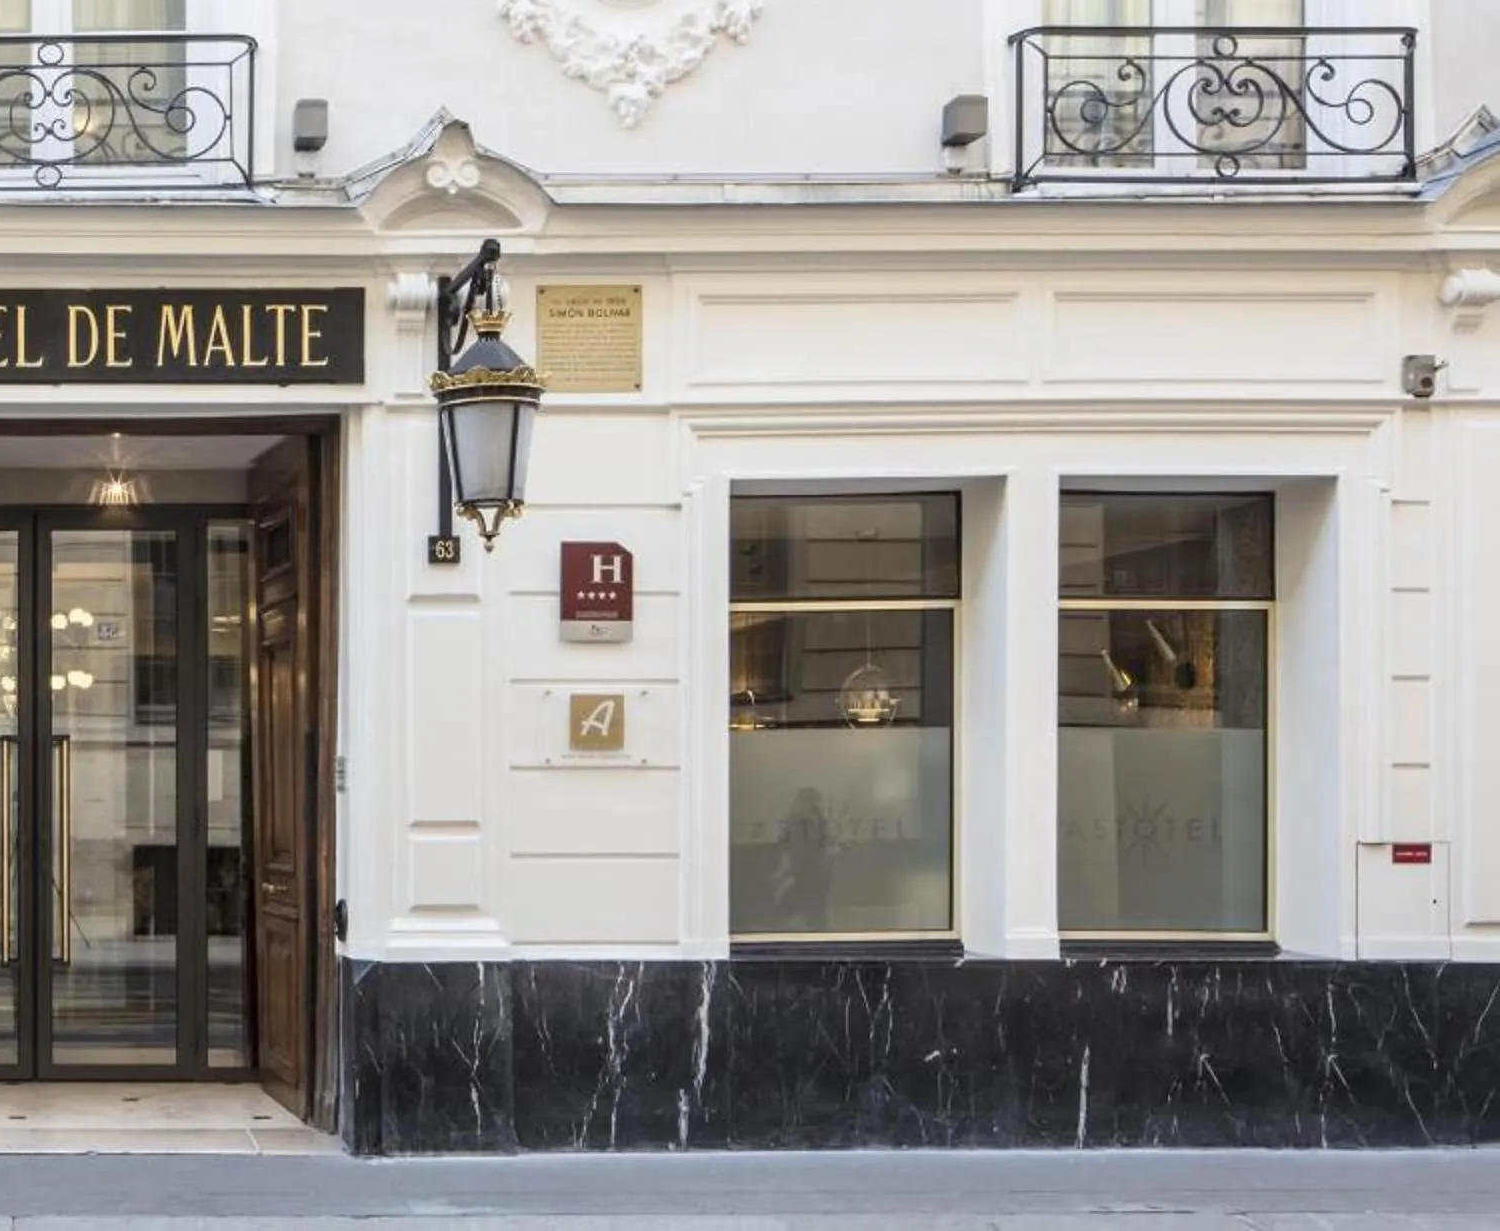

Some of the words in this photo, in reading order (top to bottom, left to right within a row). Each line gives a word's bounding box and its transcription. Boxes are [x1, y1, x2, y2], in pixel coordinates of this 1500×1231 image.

[66, 305, 133, 367] DE
[156, 304, 328, 367] MALTE
[436, 540, 455, 558] 63
[590, 554, 623, 583] H
